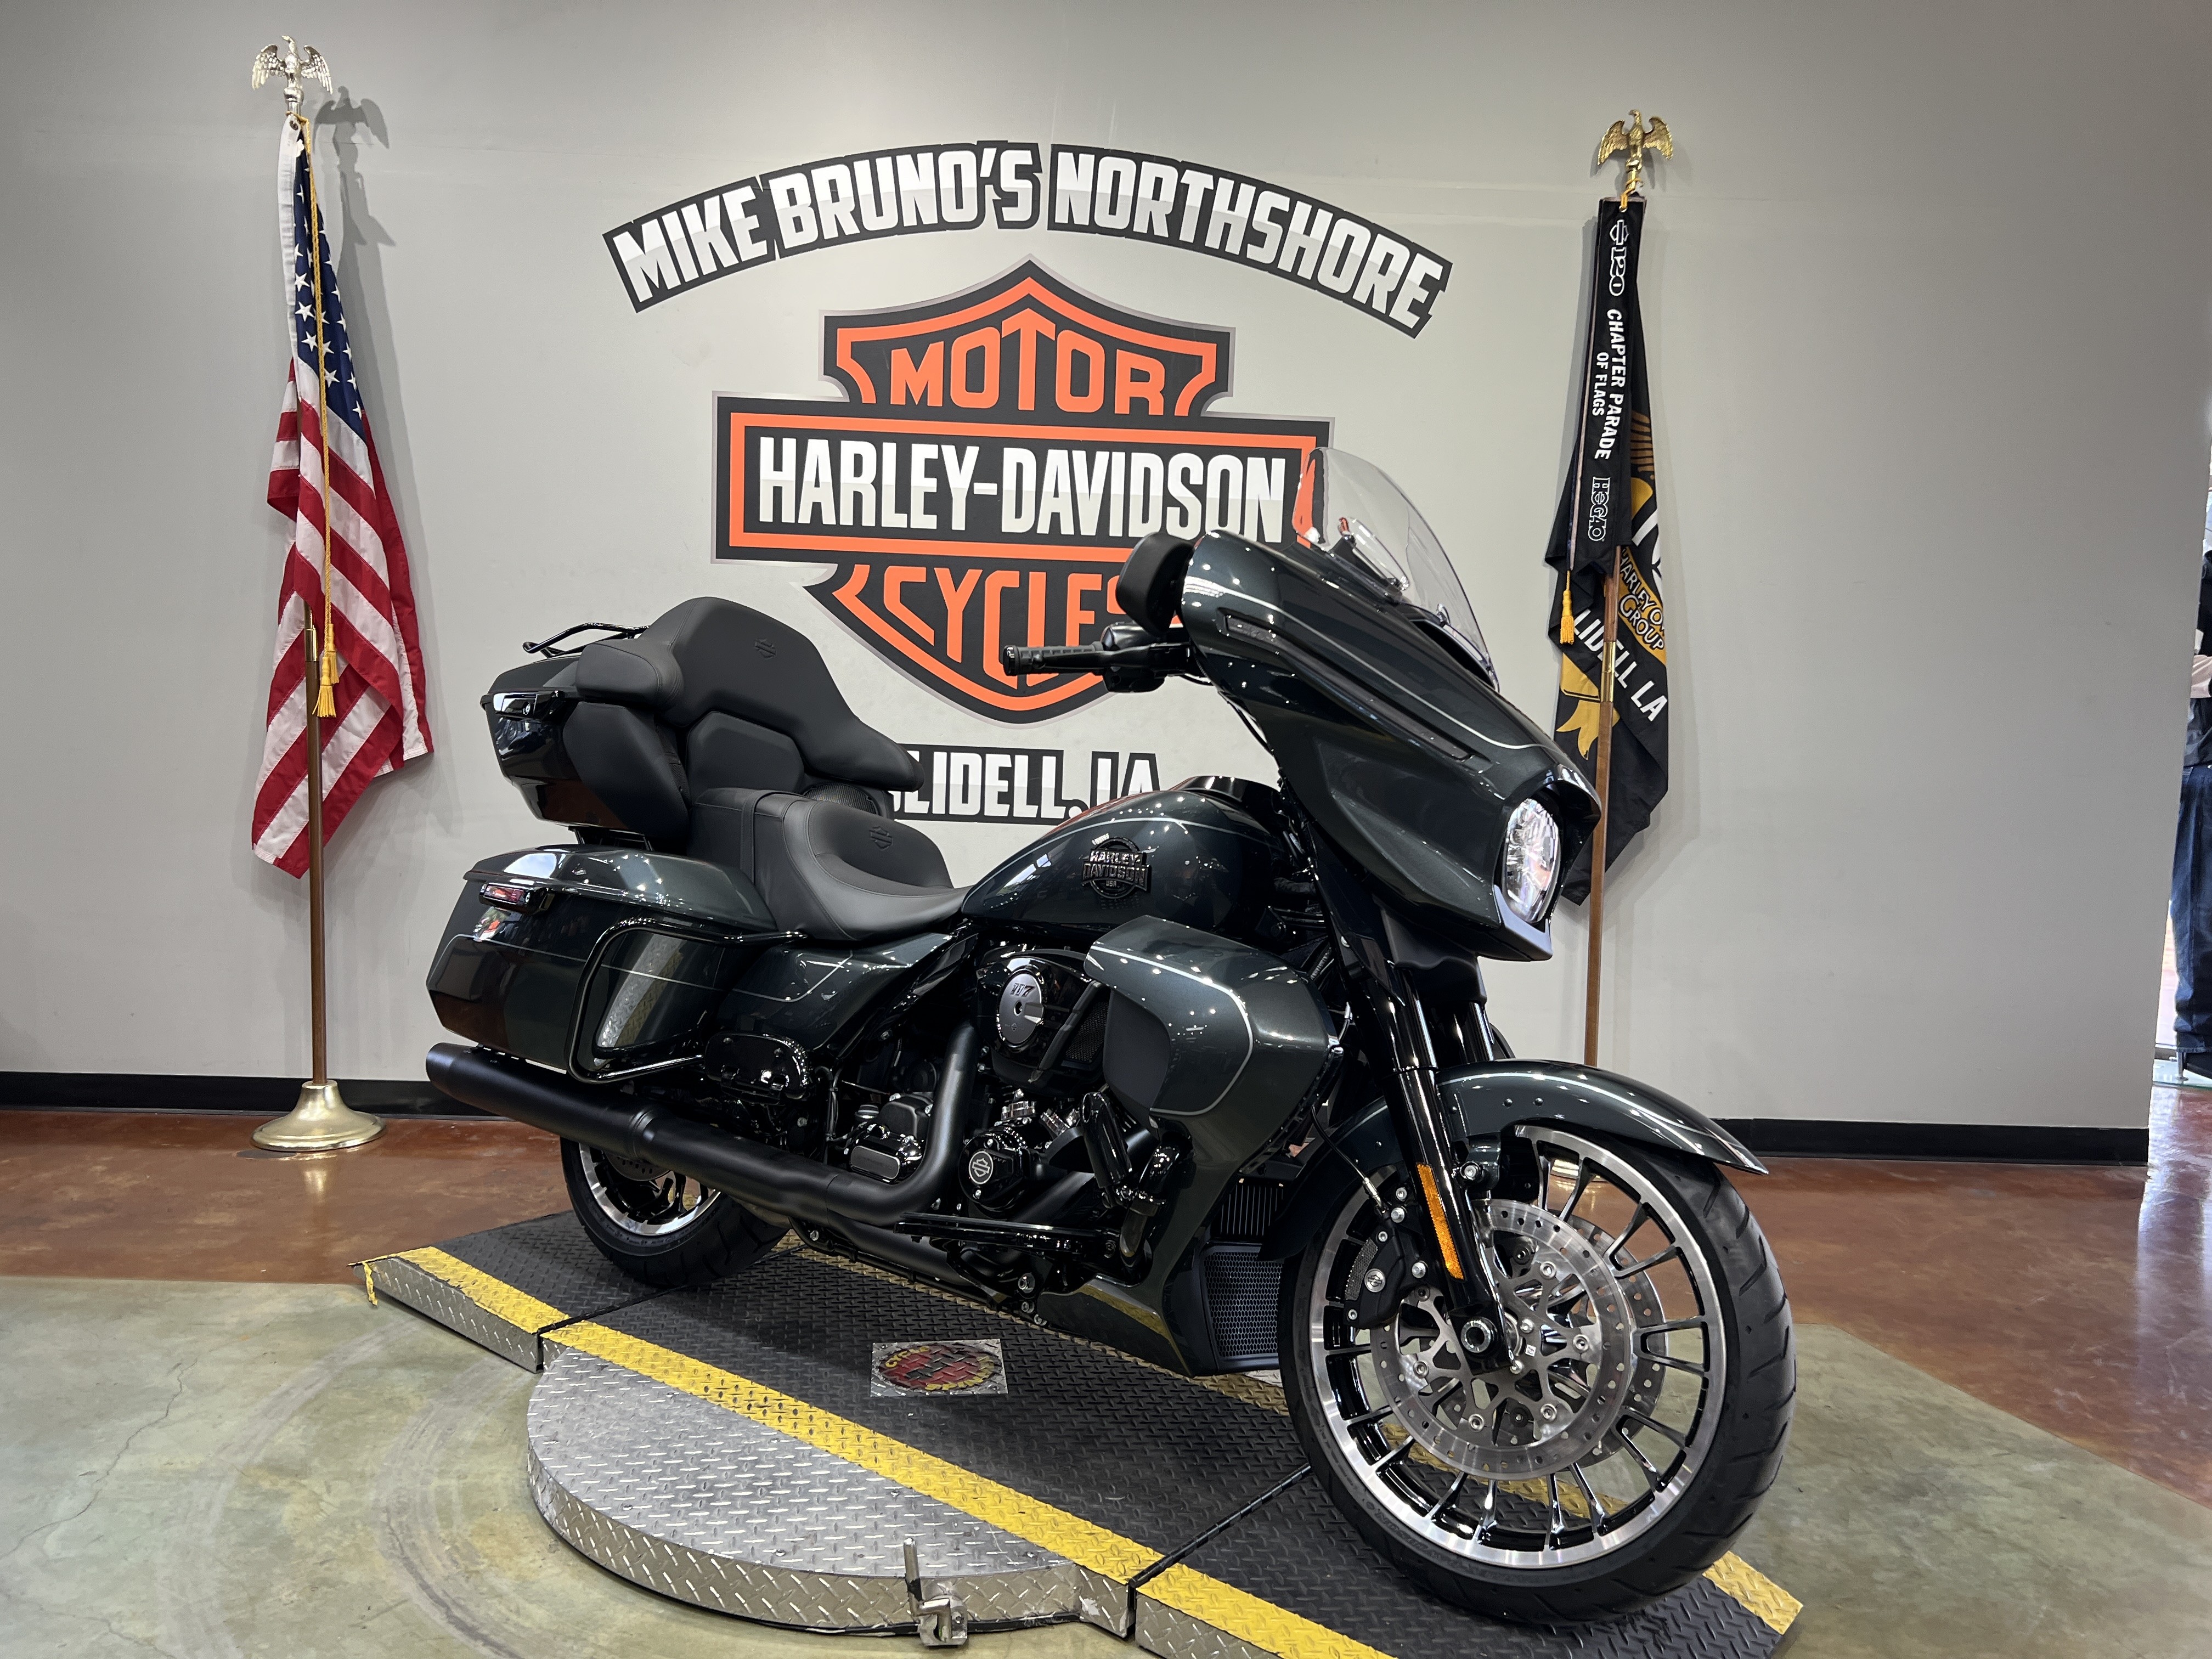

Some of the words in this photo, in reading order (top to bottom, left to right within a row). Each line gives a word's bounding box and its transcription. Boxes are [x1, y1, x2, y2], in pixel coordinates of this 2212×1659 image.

[613, 186, 768, 303] MIKE
[769, 148, 1034, 250] BRUNO'S
[1054, 151, 1443, 329] NORTHSHORE
[890, 308, 1165, 415] MOTOR
[1596, 352, 1610, 370] OF
[1606, 309, 1627, 388] CHAPTER
[1592, 374, 1608, 416] FLAGS
[1594, 393, 1624, 460] PARADE
[759, 437, 1286, 543] HARLEY-DAVIDSON
[1620, 595, 1664, 650] GROUP
[1631, 680, 1668, 722] LA
[1084, 863, 1146, 887] DAVIDSON
[1011, 983, 1036, 997] 117
